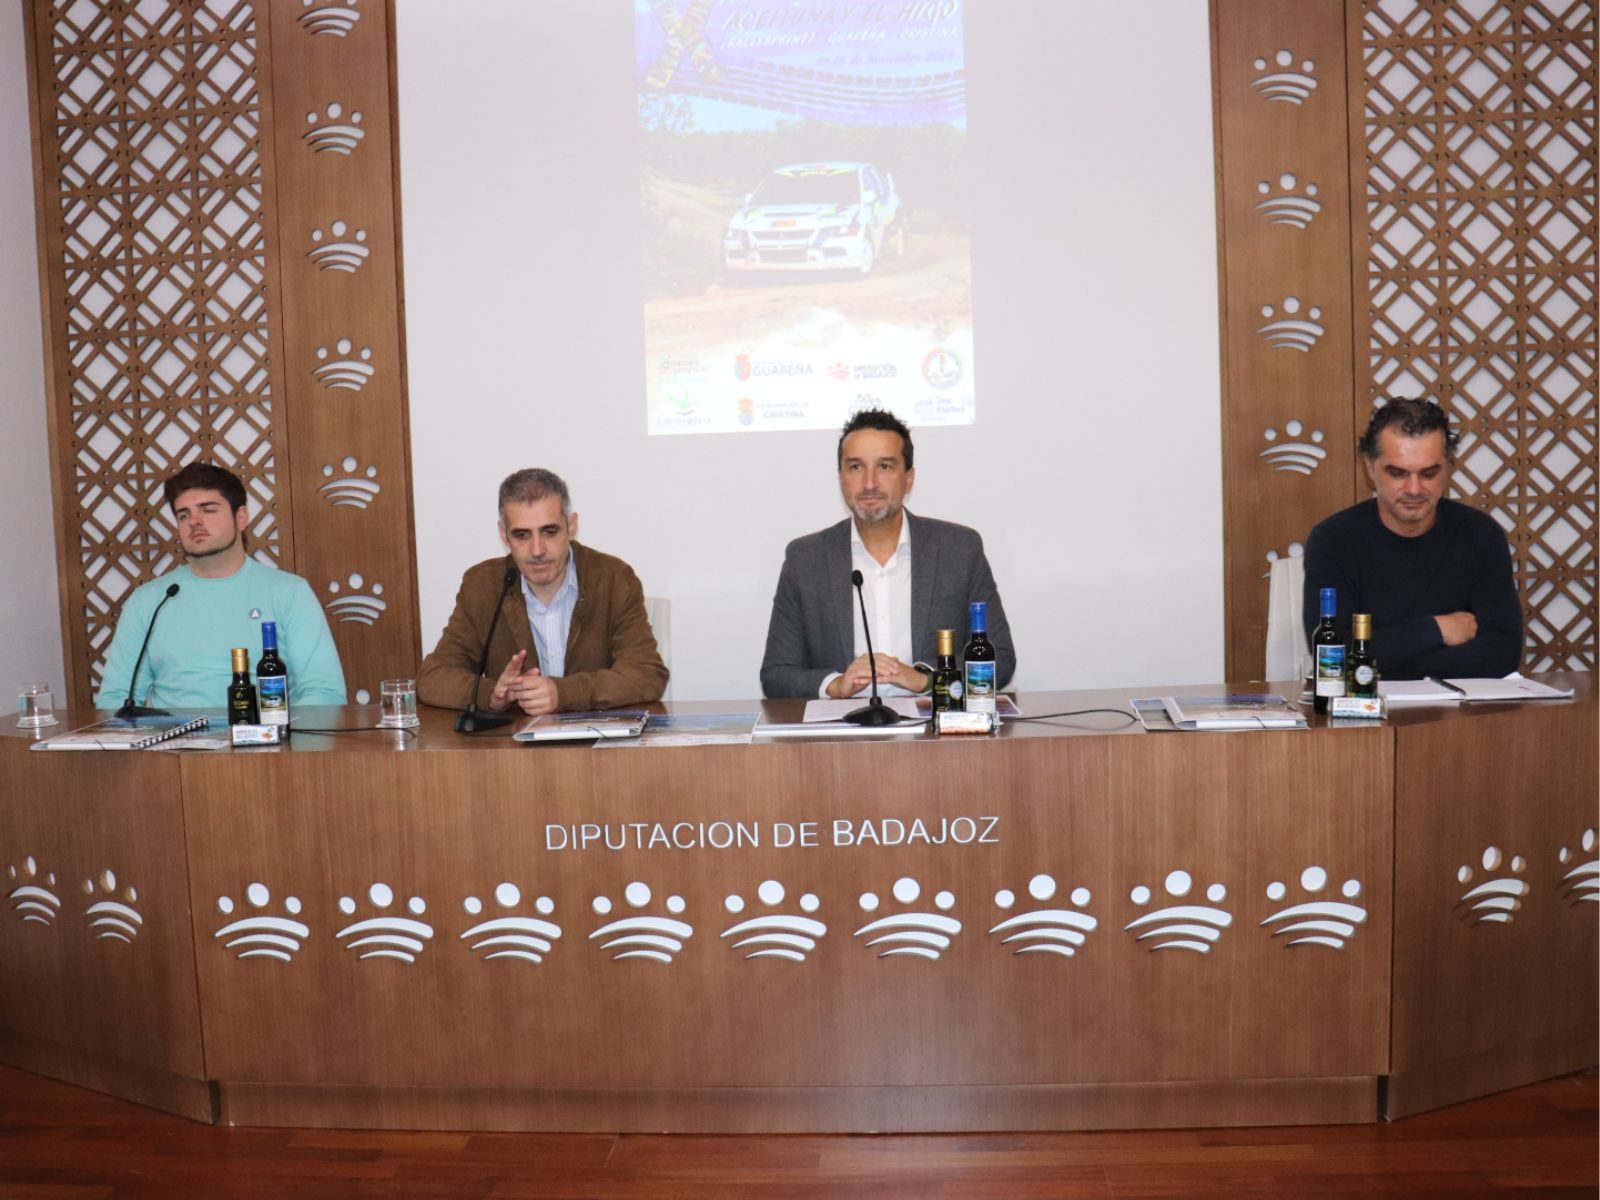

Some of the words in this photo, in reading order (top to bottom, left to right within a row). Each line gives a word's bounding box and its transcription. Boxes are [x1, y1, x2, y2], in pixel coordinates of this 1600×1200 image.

[896, 0, 959, 25] HIGO
[900, 25, 958, 41] CRISTINA
[752, 362, 814, 377] GUAREÑA
[763, 410, 805, 419] CRISTINA
[545, 822, 760, 850] DIPUTACION
[773, 822, 819, 848] DE
[832, 816, 1000, 847] BADAJOZ
